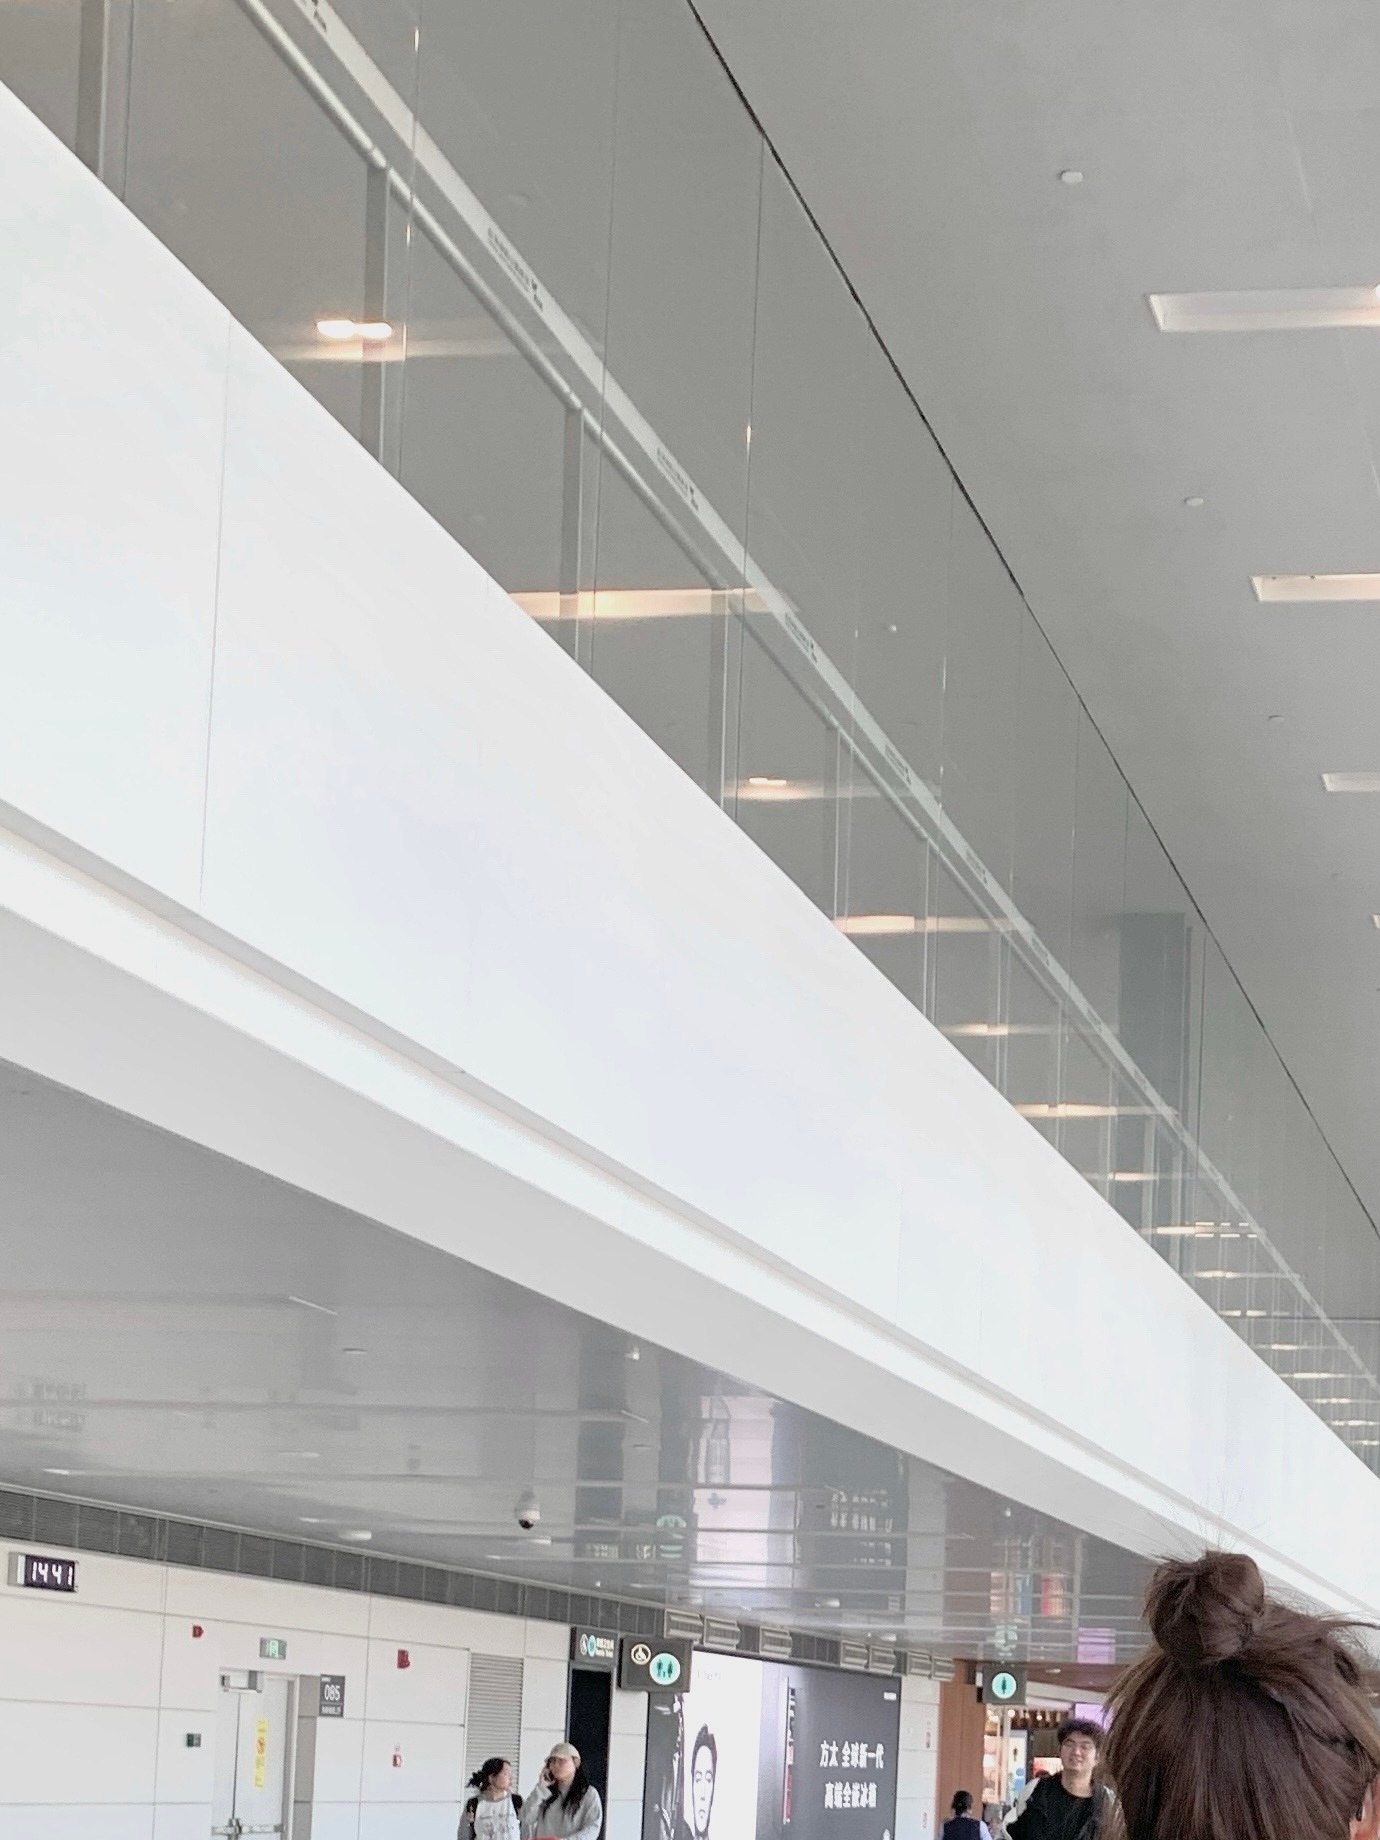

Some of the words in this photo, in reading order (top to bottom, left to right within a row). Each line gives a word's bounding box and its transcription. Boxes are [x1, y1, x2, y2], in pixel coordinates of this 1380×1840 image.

[324, 1684, 340, 1700] 085
[820, 1740, 839, 1768] 方太
[841, 1740, 884, 1769] 全球新一代
